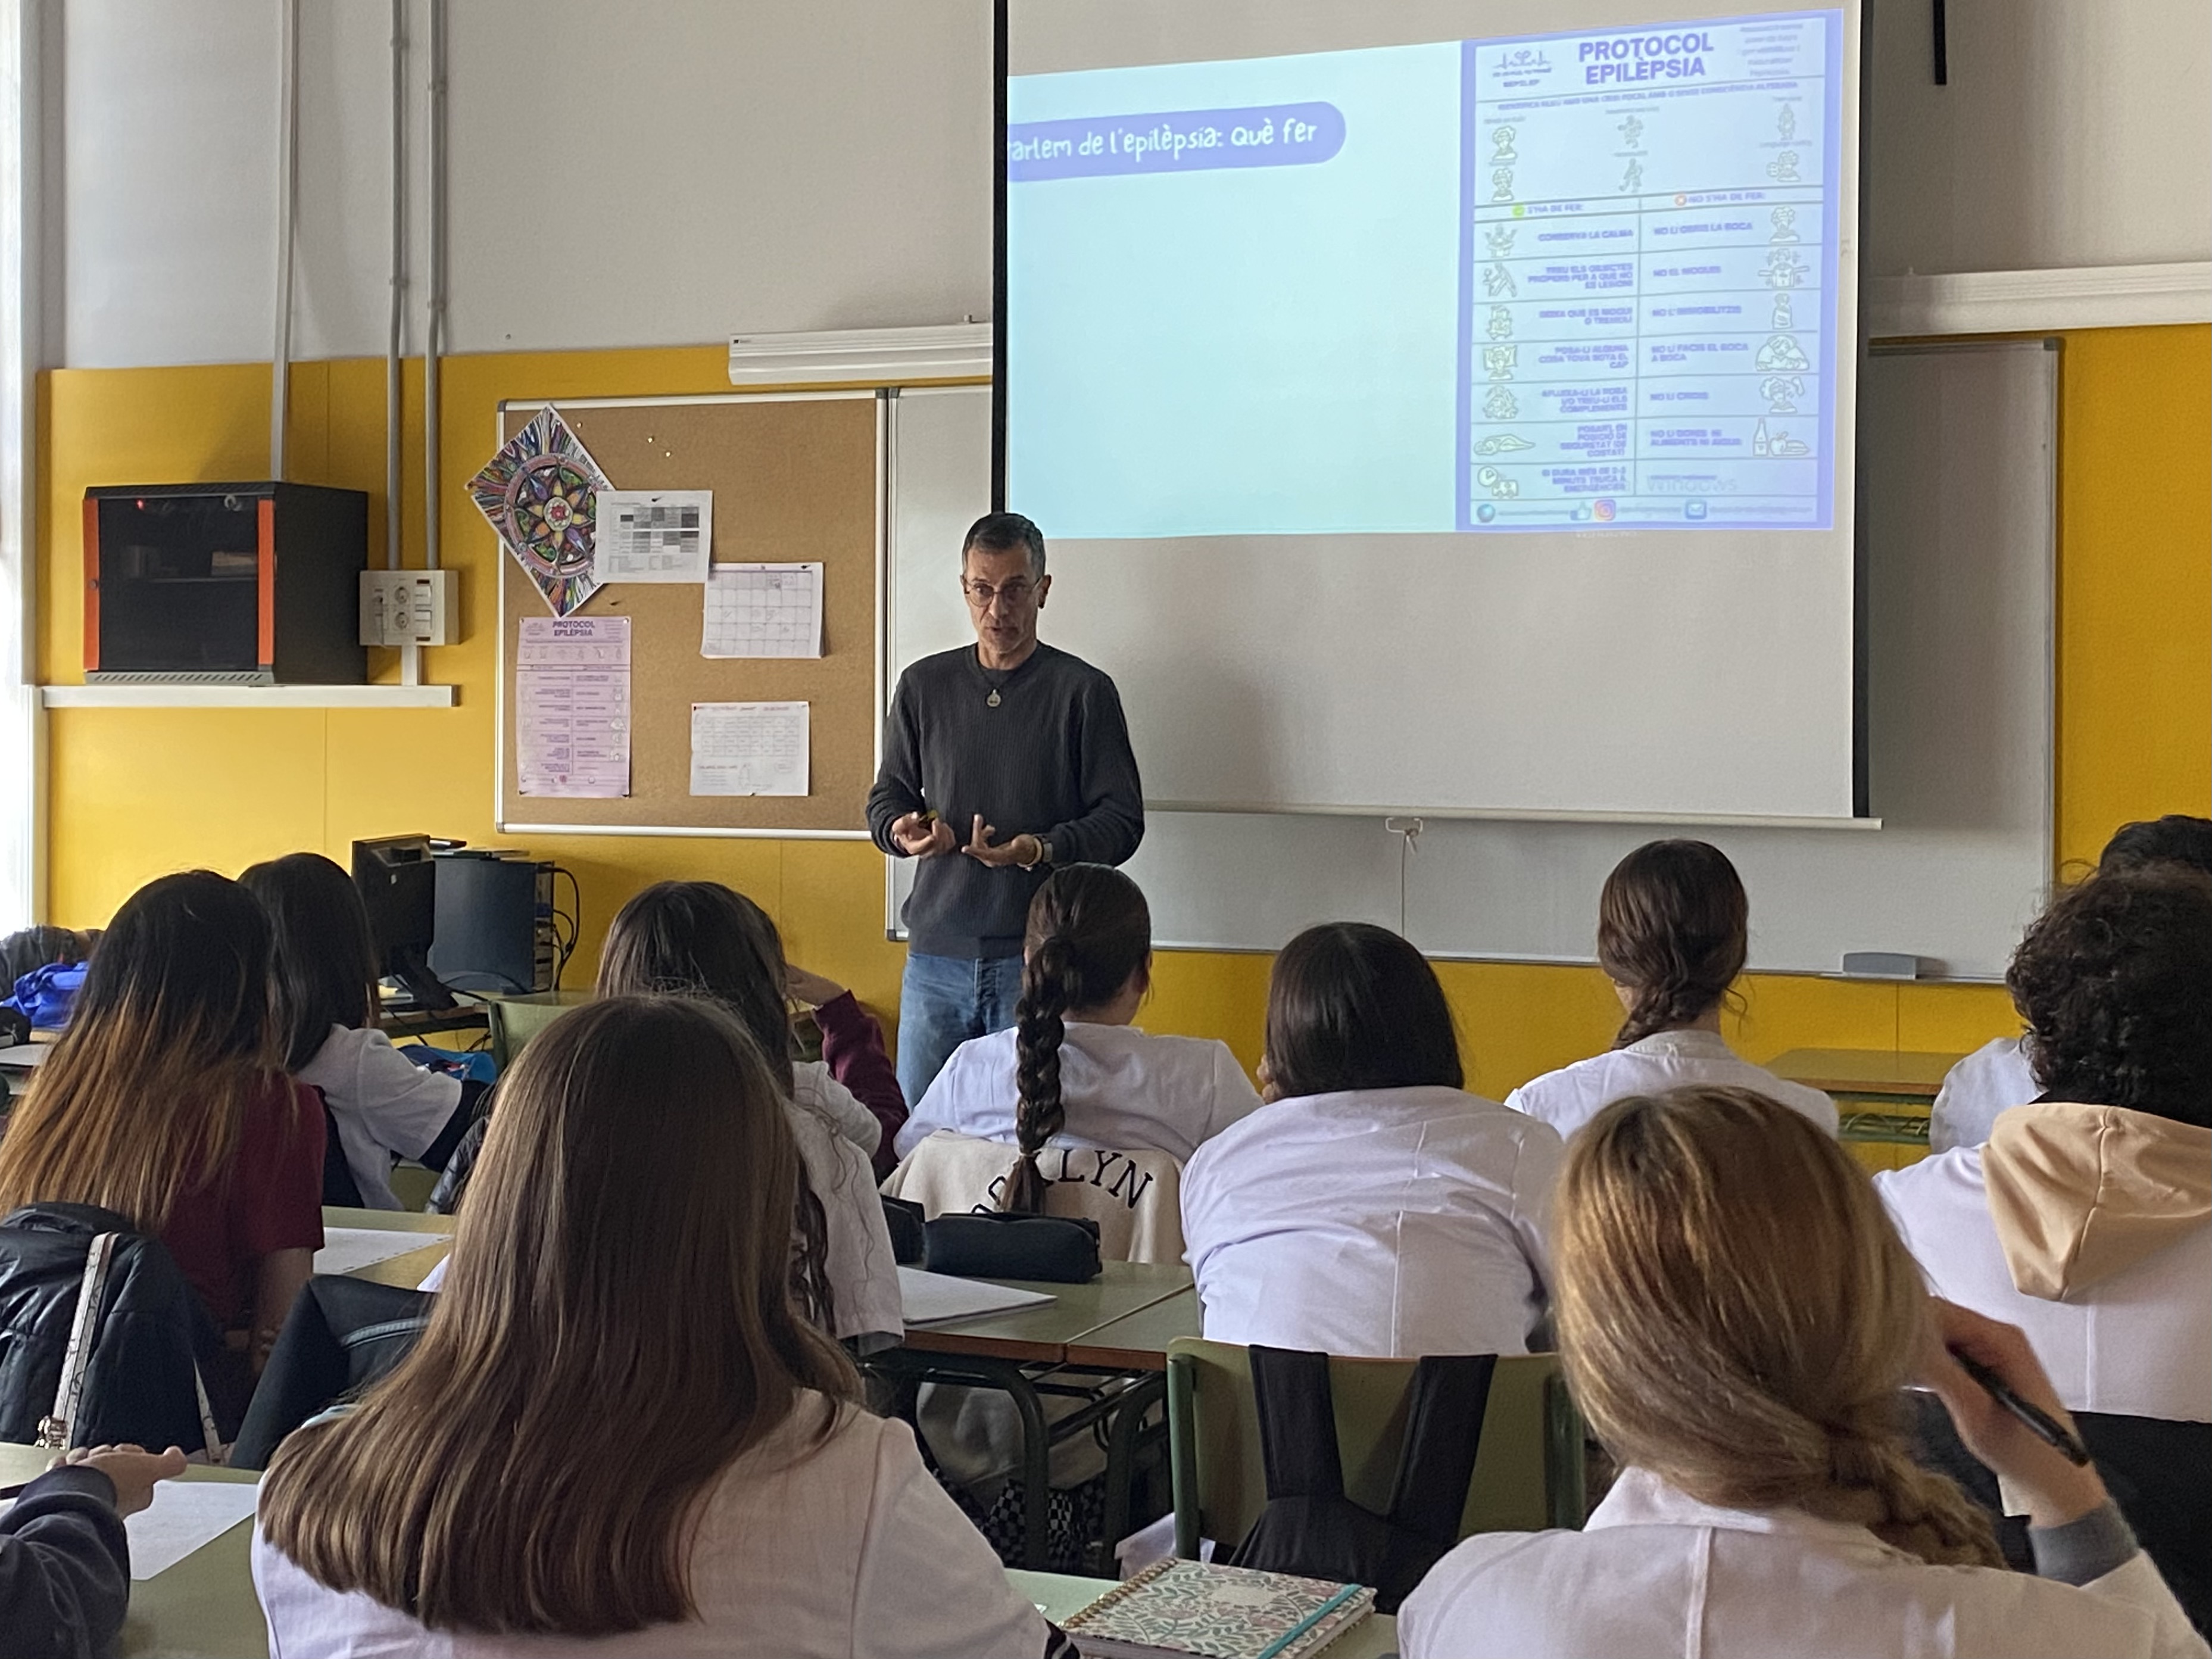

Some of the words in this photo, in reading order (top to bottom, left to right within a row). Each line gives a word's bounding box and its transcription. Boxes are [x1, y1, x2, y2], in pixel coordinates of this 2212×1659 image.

[1579, 32, 1714, 62] PROTOCOL
[1586, 57, 1706, 85] EPILÈPSIA
[1007, 136, 1072, 161] arlem
[1078, 130, 1104, 156] de
[1230, 117, 1274, 146] Què
[1283, 117, 1318, 144] fer
[1687, 195, 1704, 204] NO
[1706, 193, 1727, 202] S'HA
[1730, 192, 1743, 201] DE
[1745, 191, 1766, 200] FER:
[1550, 204, 1563, 213] DE
[1653, 227, 1668, 235] NO
[1711, 223, 1723, 232] LA
[1724, 222, 1753, 231] BOCA
[1589, 231, 1600, 239] LA
[1602, 229, 1634, 239] CALMA
[1571, 264, 1587, 273] ELS
[1653, 268, 1667, 277] NO
[1572, 273, 1589, 282] PER
[1599, 272, 1617, 280] QUE
[1619, 271, 1633, 279] NO
[1568, 309, 1586, 317] QUE
[1584, 317, 1592, 325] O
[1651, 345, 1666, 354] NO
[1707, 344, 1719, 352] EL
[1721, 342, 1749, 351] BOCA
[1618, 353, 1628, 361] EL
[1660, 353, 1687, 361] BOCA
[1609, 361, 1629, 369] CAP
[1590, 388, 1600, 397] LA
[1611, 395, 1628, 403] ELS
[1651, 429, 1665, 438] NO
[554, 628, 593, 637] EPILÈPSIA
